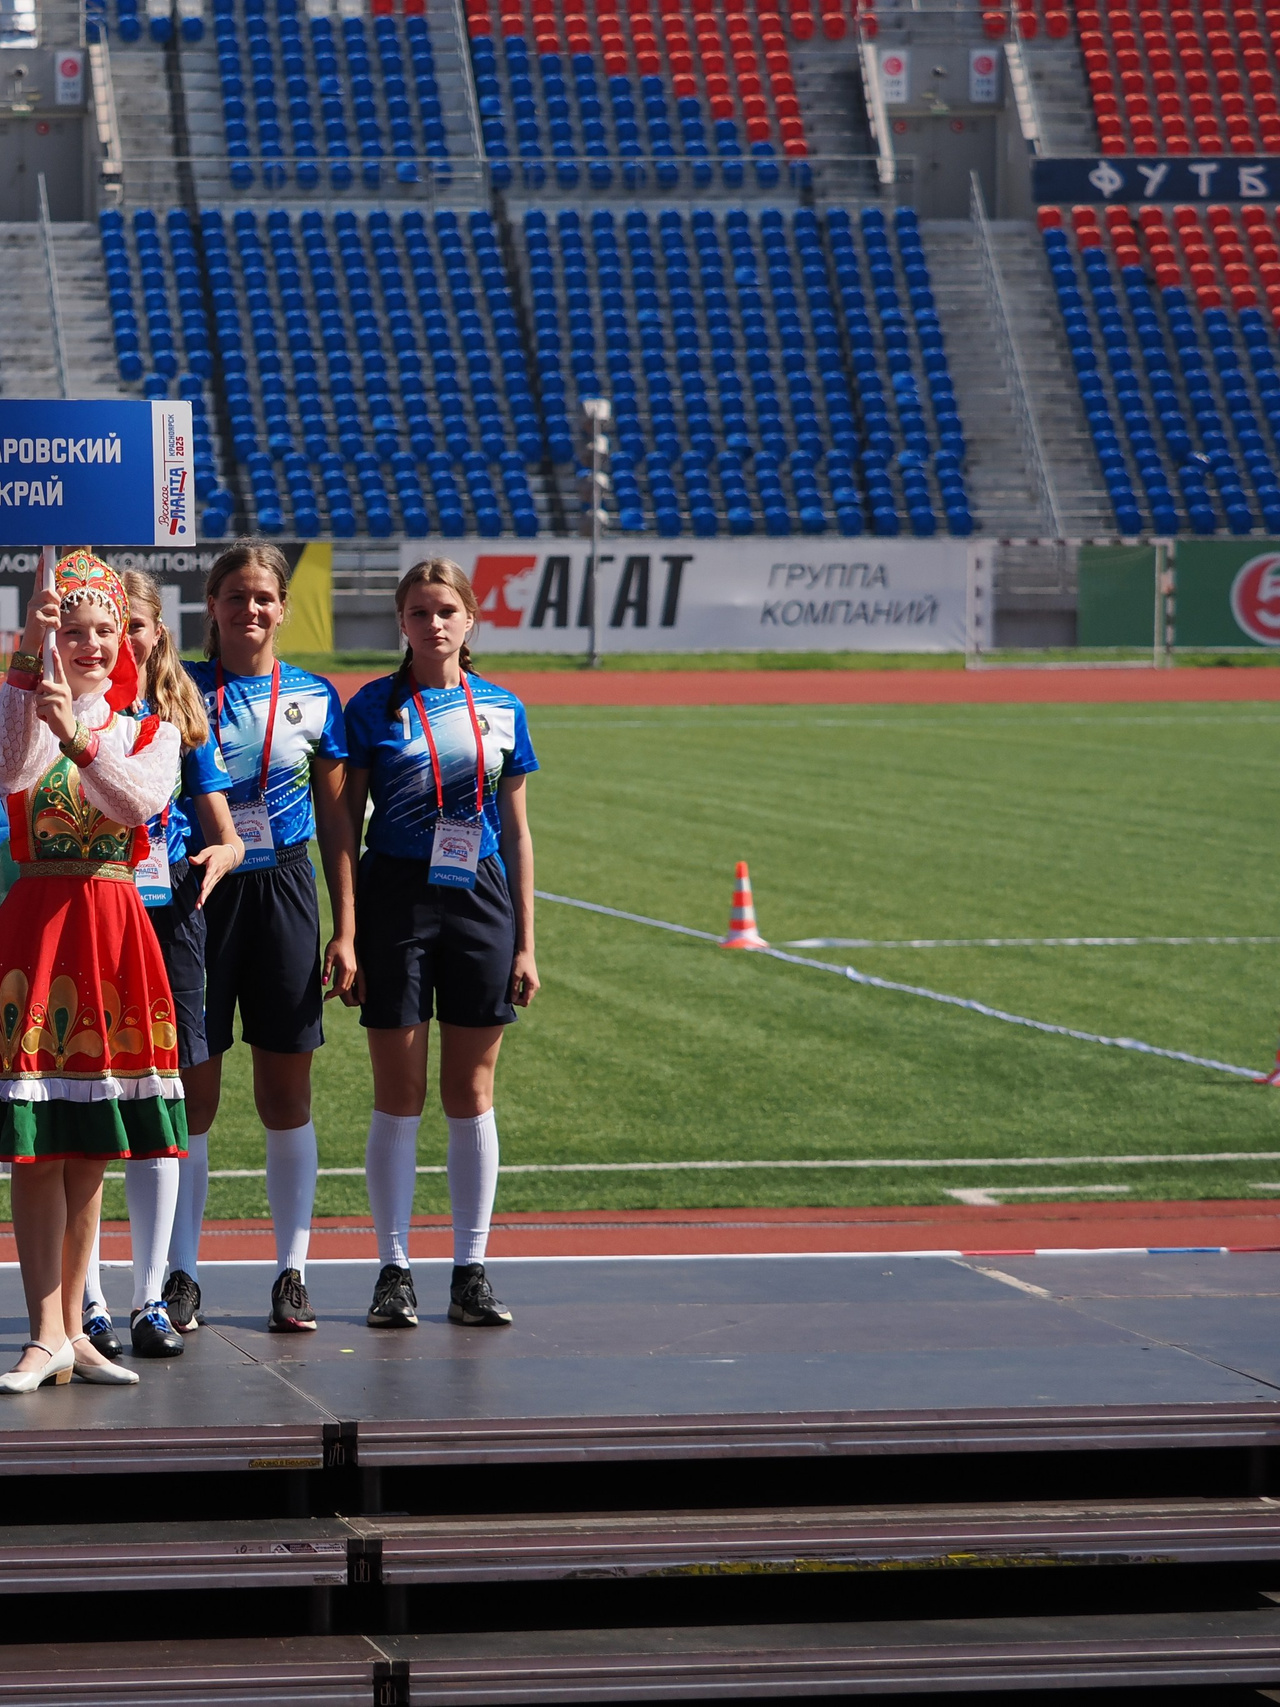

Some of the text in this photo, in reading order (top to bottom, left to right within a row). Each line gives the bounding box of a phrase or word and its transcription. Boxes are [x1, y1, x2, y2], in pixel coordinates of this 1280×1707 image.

[1088, 160, 1268, 198] ФУТБ
[168, 413, 176, 457] КРАСНОЯРСК
[176, 436, 185, 457] 2025
[767, 562, 888, 590] ГРУППА
[529, 555, 694, 628] АГАТ
[759, 594, 939, 627] КОМПАНИЙ
[242, 855, 270, 866] АСТНИК
[434, 872, 470, 884] УЧАСТНИК
[140, 893, 167, 901] АСТНИК
